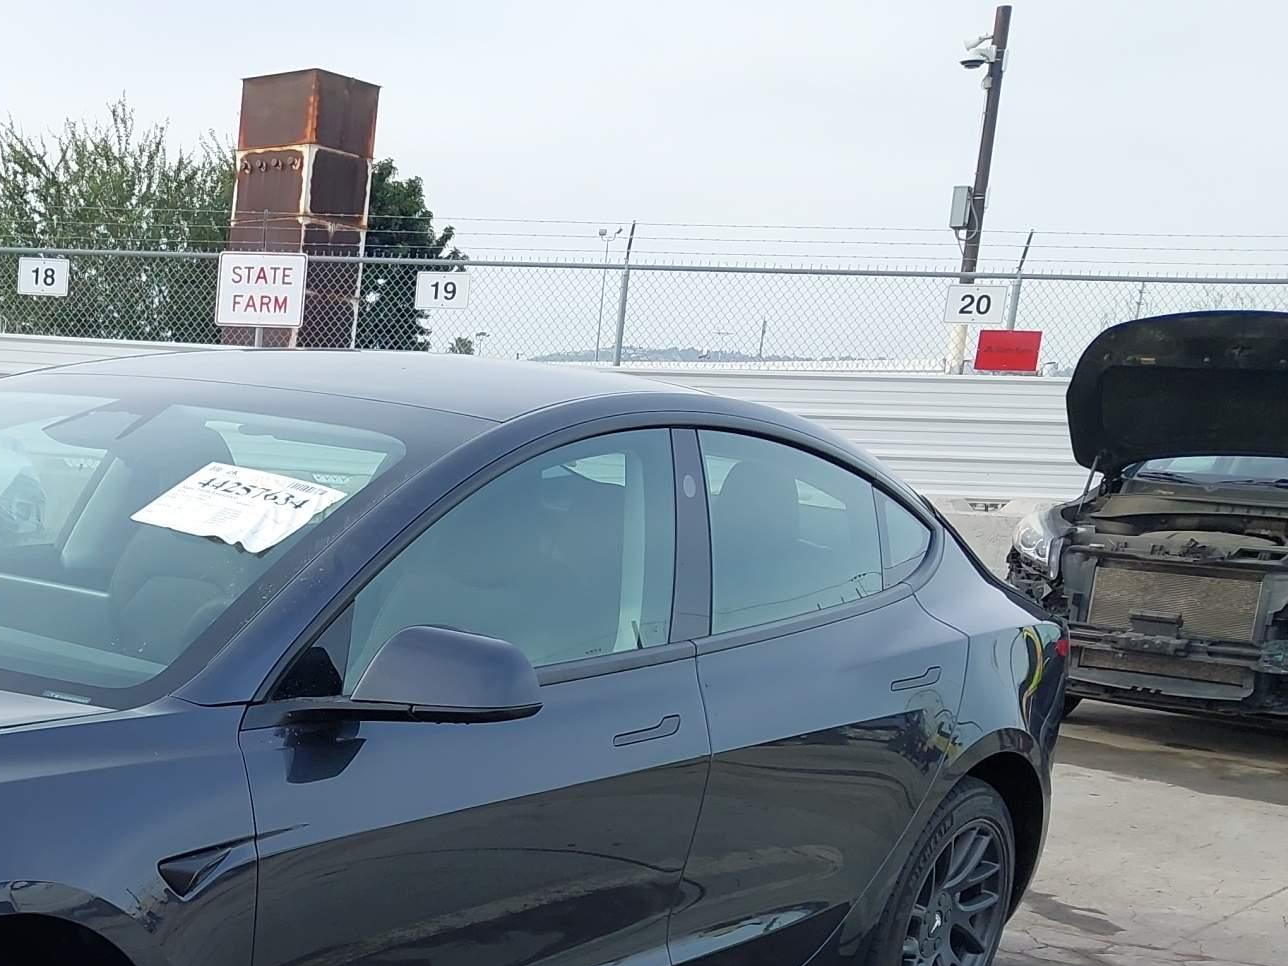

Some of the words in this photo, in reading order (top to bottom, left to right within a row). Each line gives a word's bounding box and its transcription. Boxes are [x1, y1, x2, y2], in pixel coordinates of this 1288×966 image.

[30, 268, 56, 286] 18
[231, 265, 293, 286] STATE
[430, 281, 457, 301] 19
[231, 294, 288, 314] FARM
[958, 294, 992, 315] 20
[198, 477, 310, 510] 44257634
